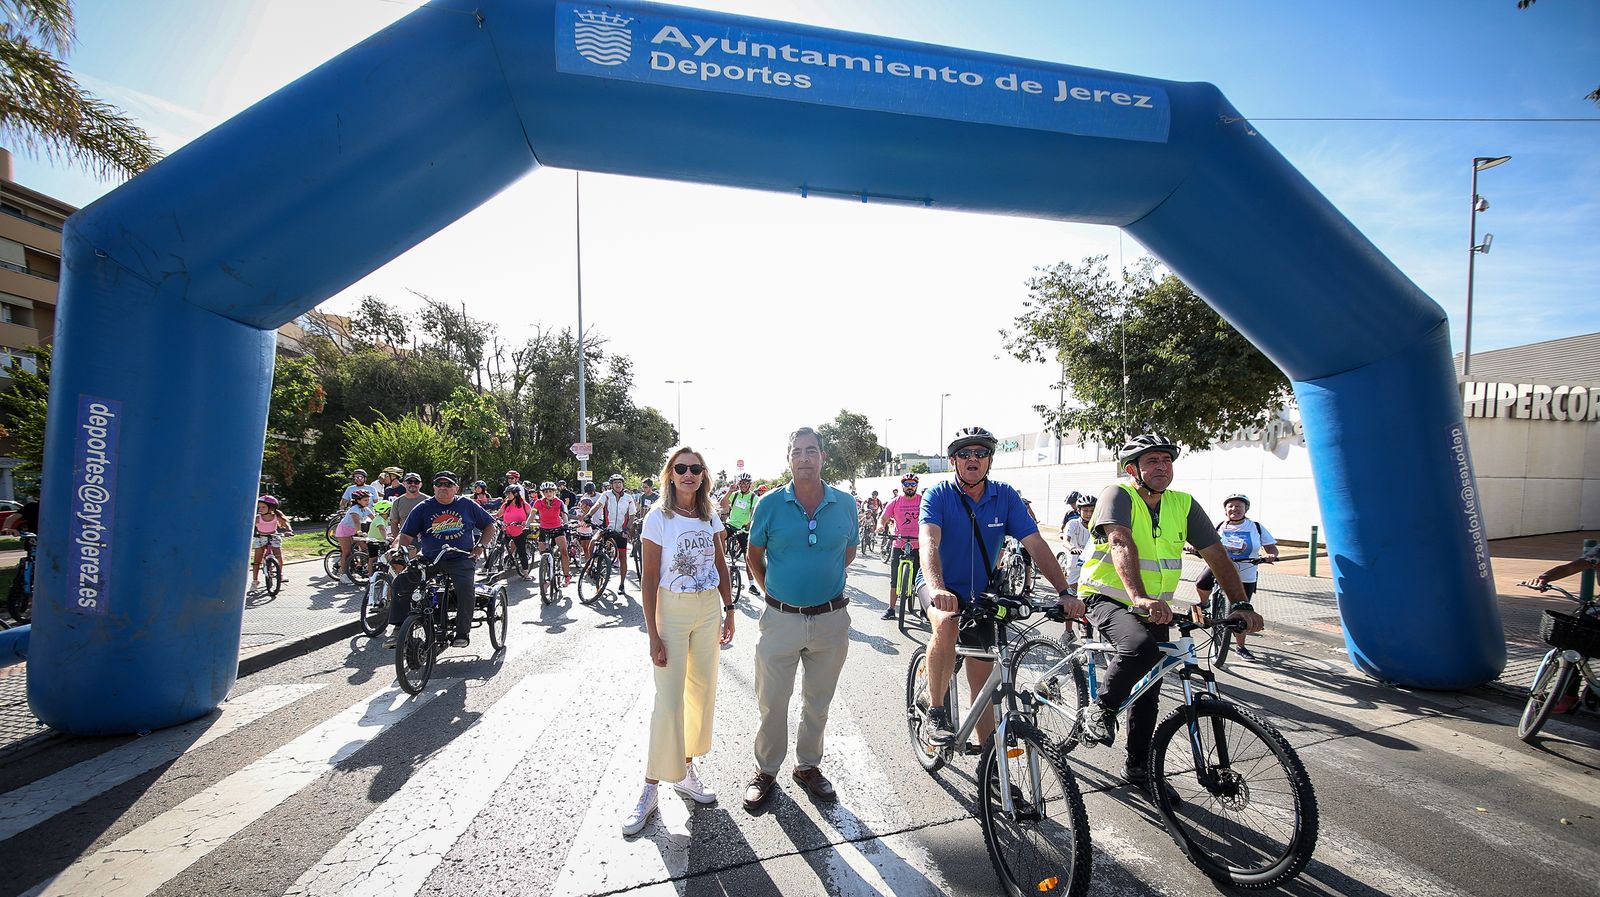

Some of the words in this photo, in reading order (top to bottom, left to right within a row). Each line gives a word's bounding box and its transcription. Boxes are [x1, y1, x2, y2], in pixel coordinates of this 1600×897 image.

[650, 25, 984, 86] Ayuntamiento
[994, 73, 1043, 94] de
[1053, 79, 1154, 109] Jerez
[650, 50, 813, 89] Deportes
[76, 402, 115, 609] deportes@aytojerez.es
[684, 537, 713, 551] PARIS
[1451, 427, 1489, 580] deportes@aytojerez.es
